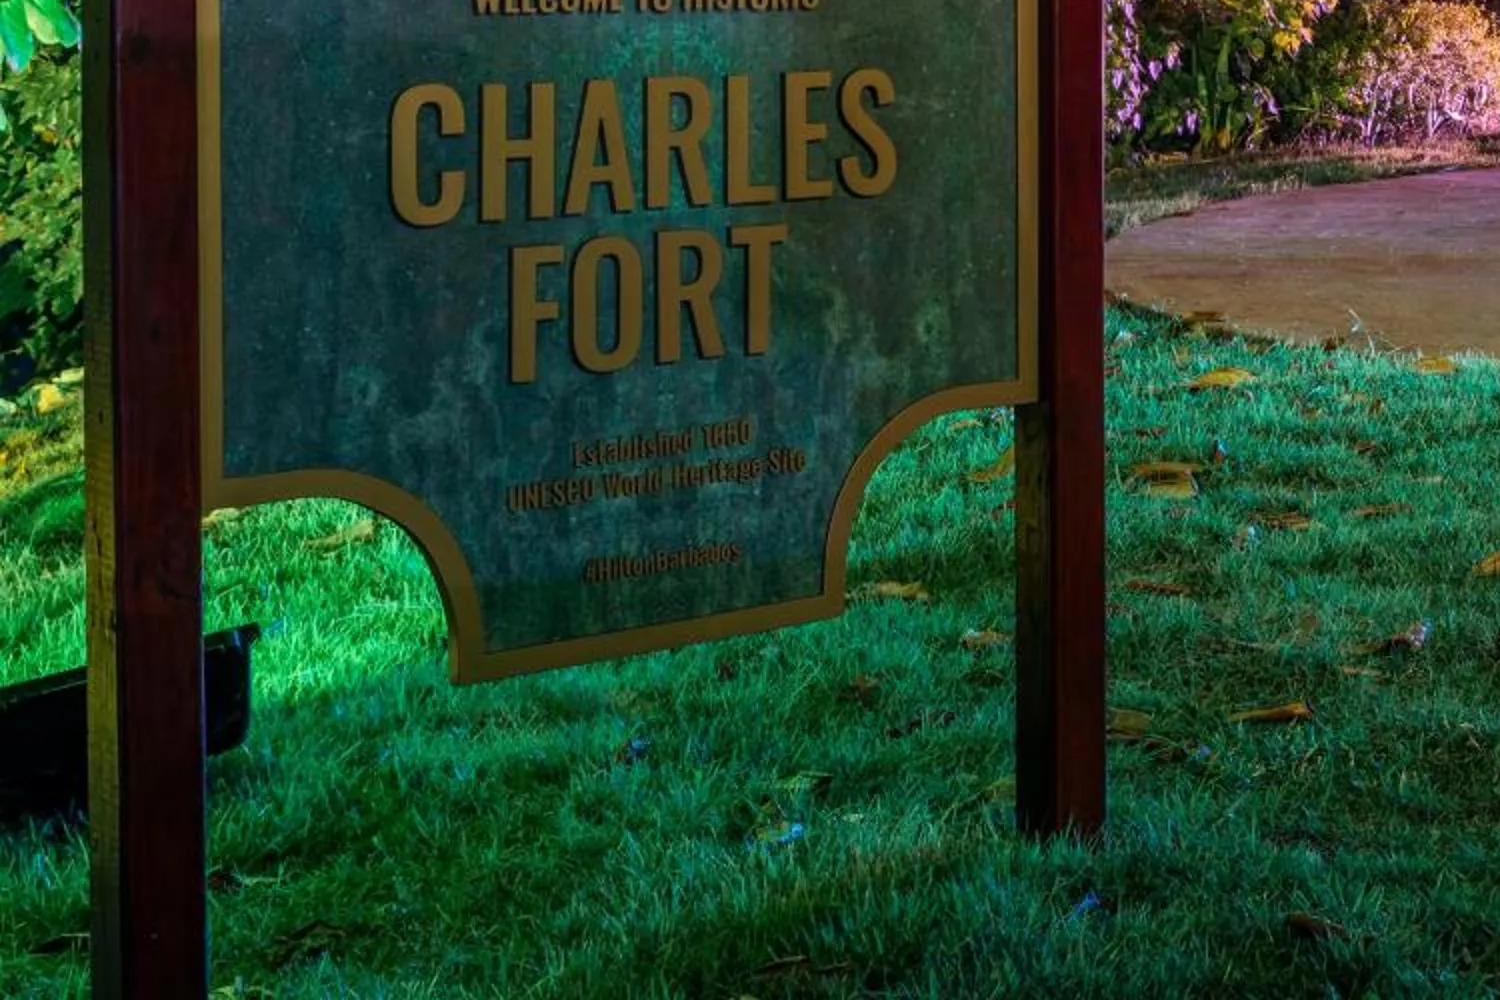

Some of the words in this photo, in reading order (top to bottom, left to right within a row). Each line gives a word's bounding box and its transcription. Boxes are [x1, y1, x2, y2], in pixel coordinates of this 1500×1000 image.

[390, 68, 898, 227] CHARLES
[510, 223, 788, 384] FORT
[508, 479, 595, 513] UNESCO
[603, 468, 662, 499] World
[673, 457, 761, 489] Heritage
[769, 449, 806, 475] Site
[572, 430, 693, 468] Established
